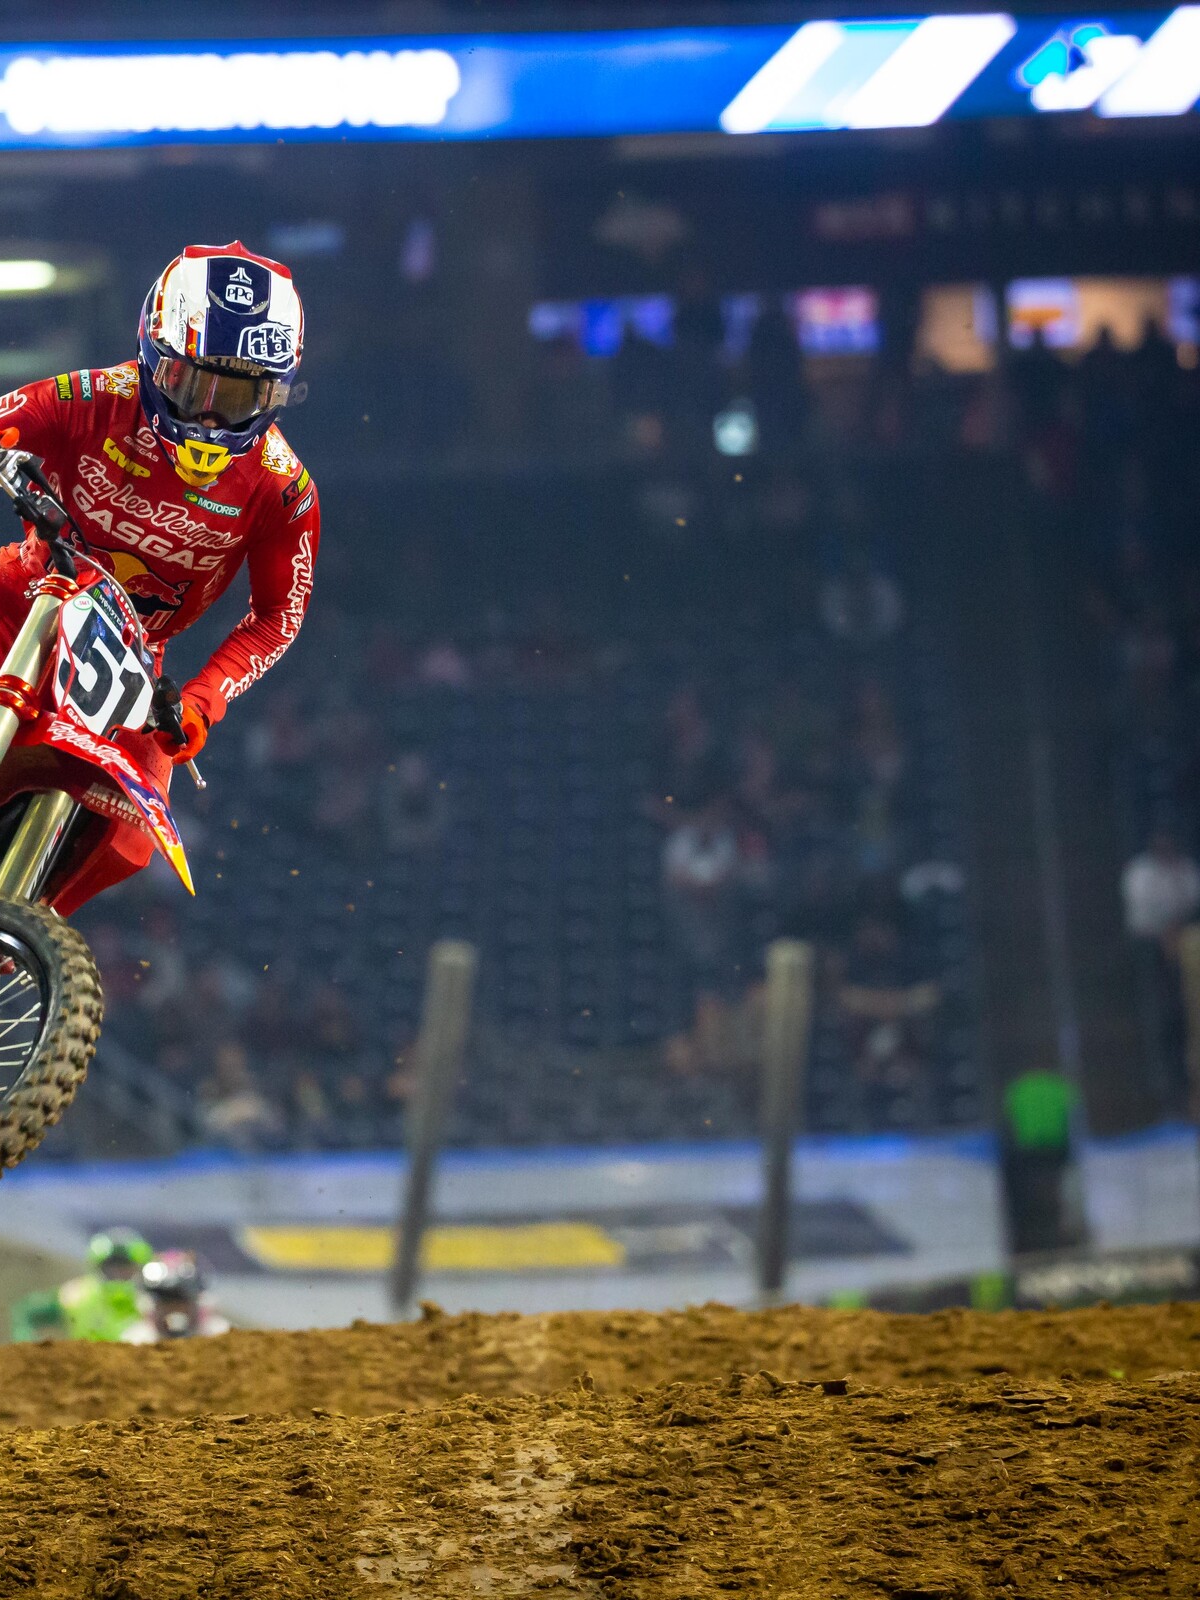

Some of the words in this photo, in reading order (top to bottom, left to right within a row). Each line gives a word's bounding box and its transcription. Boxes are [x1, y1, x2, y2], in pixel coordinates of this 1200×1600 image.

[227, 287, 252, 302] PPG
[72, 483, 226, 571] GASGAS
[78, 454, 117, 500] Troy
[110, 483, 153, 519] Lee
[151, 501, 243, 550] Designs
[198, 497, 243, 517] MOTOREX
[58, 605, 146, 736] 51
